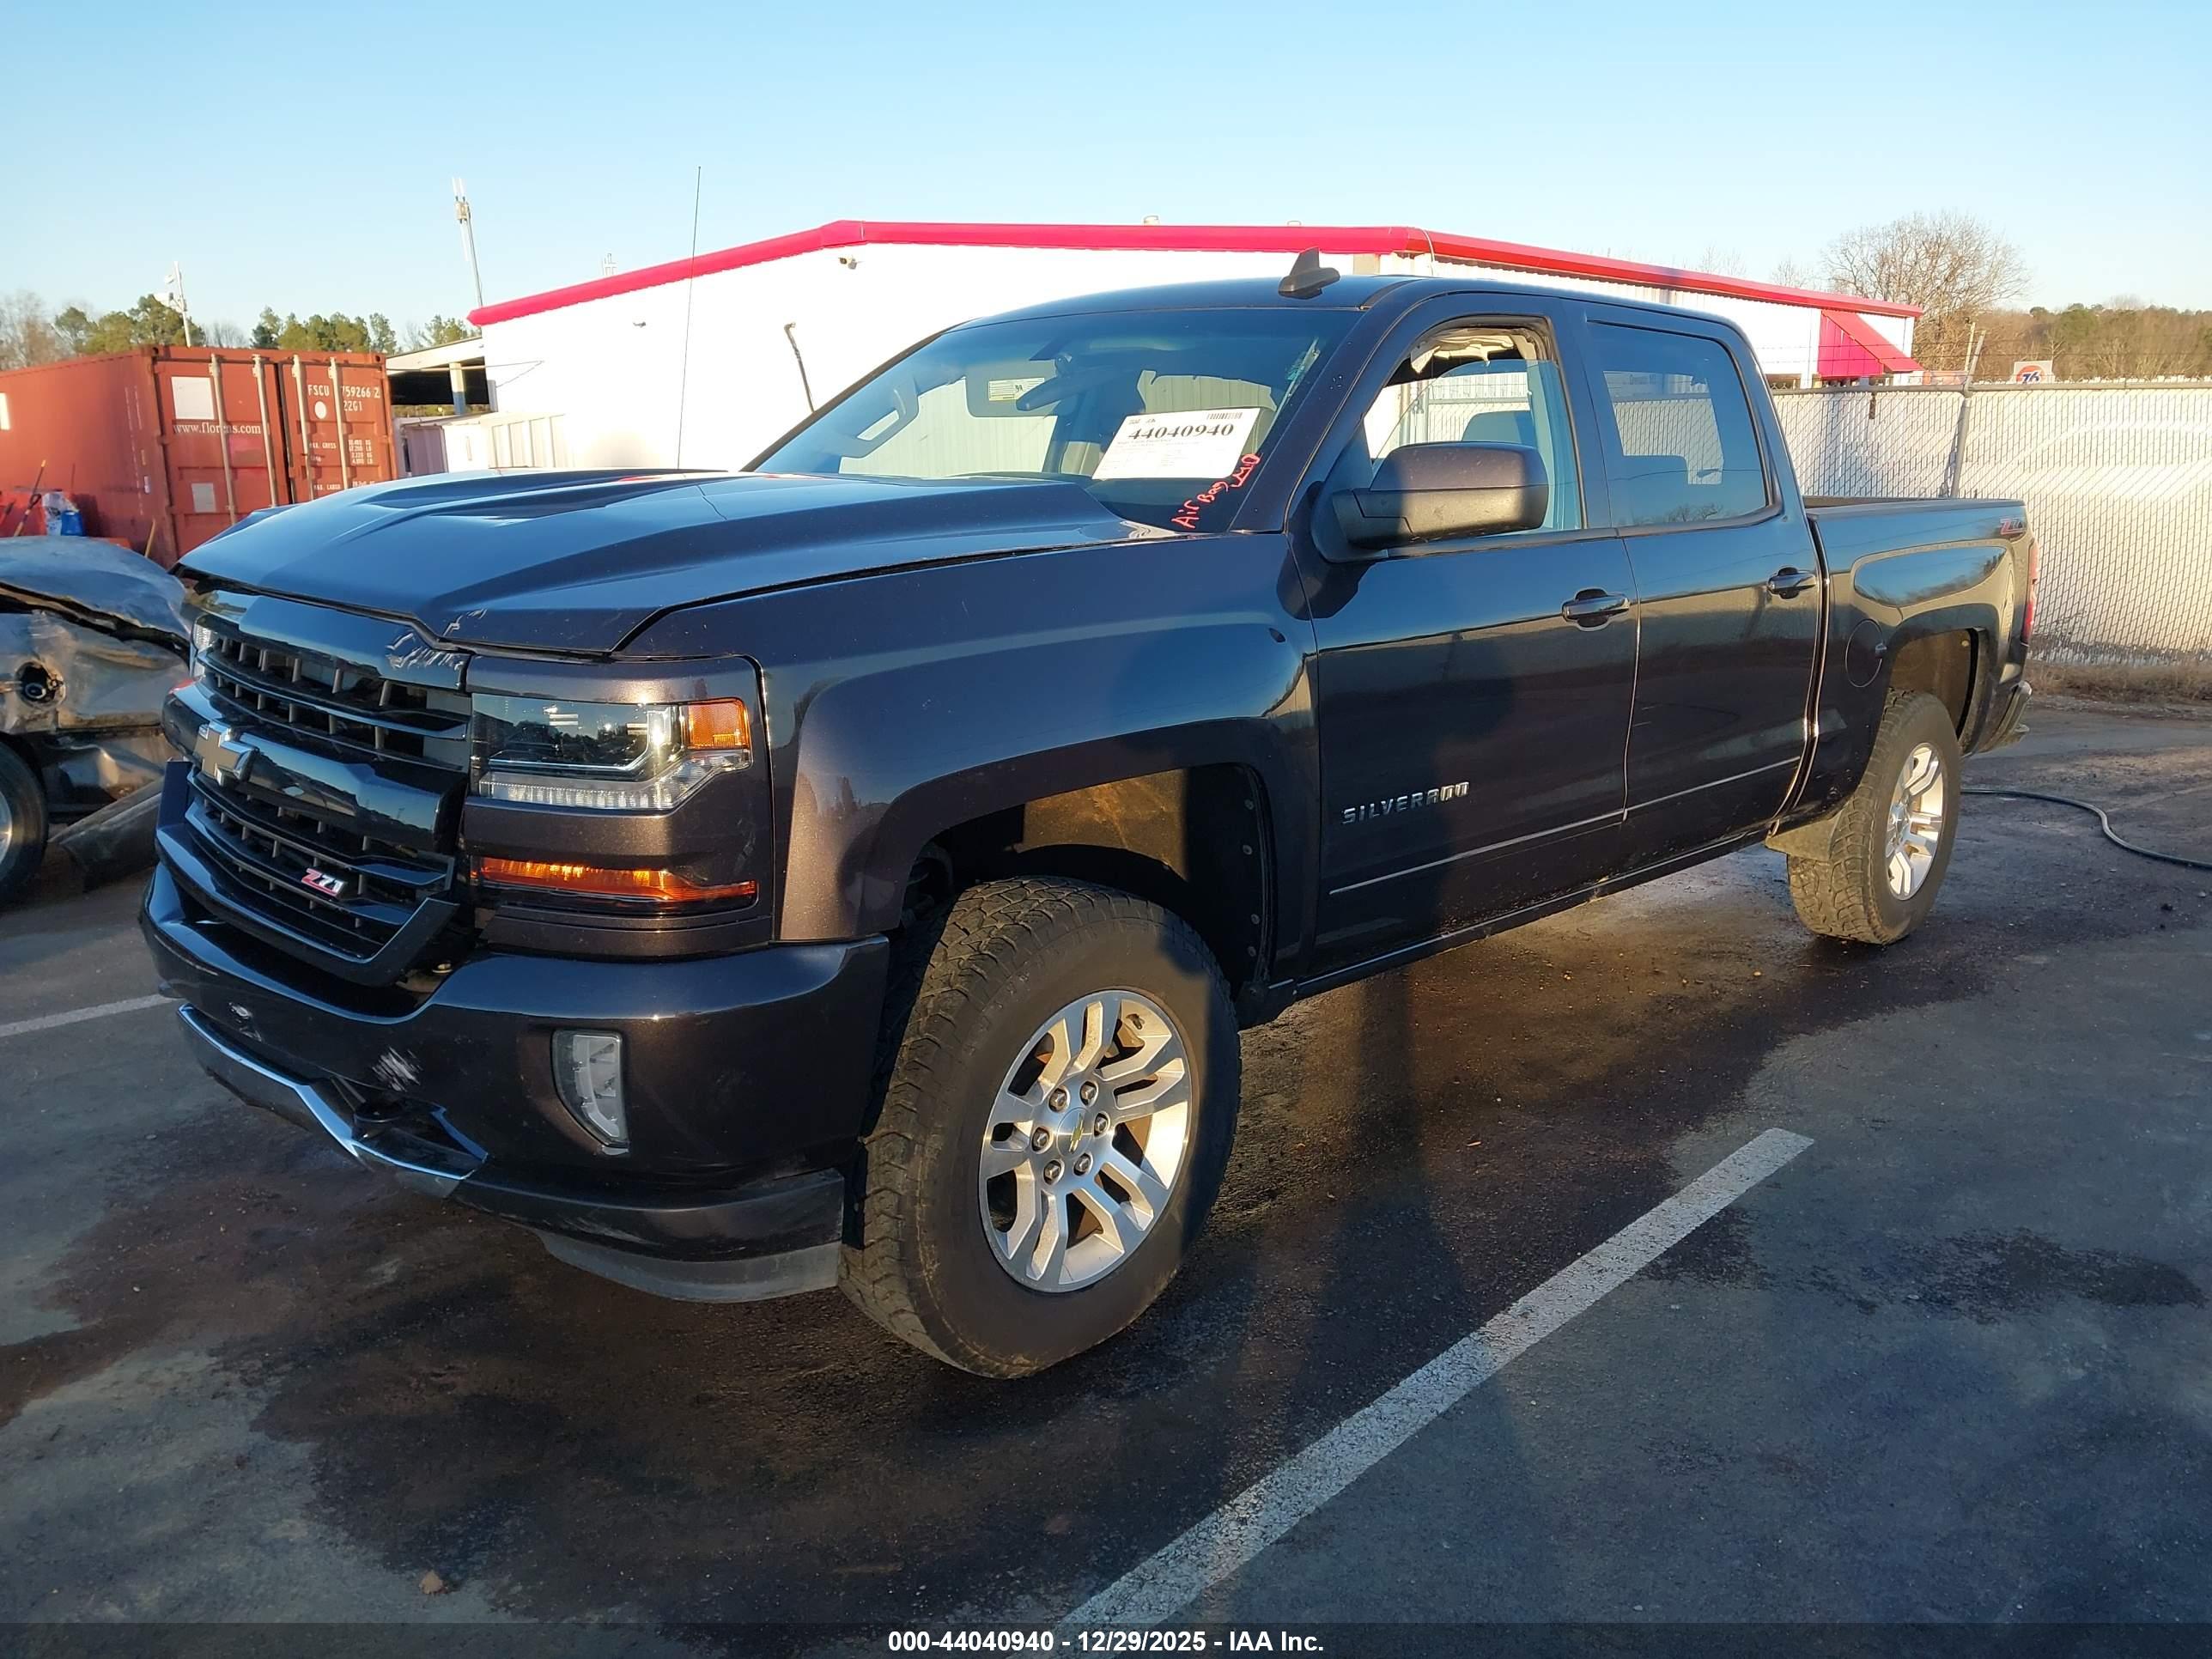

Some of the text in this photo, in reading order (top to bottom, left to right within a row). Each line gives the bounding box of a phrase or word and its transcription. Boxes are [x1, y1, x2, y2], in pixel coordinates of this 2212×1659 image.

[307, 384, 330, 396] FSCU
[1127, 423, 1234, 440] 44040940
[1170, 500, 1200, 529] Air
[1340, 781, 1469, 825] SILVERADO
[301, 867, 344, 896] Z71
